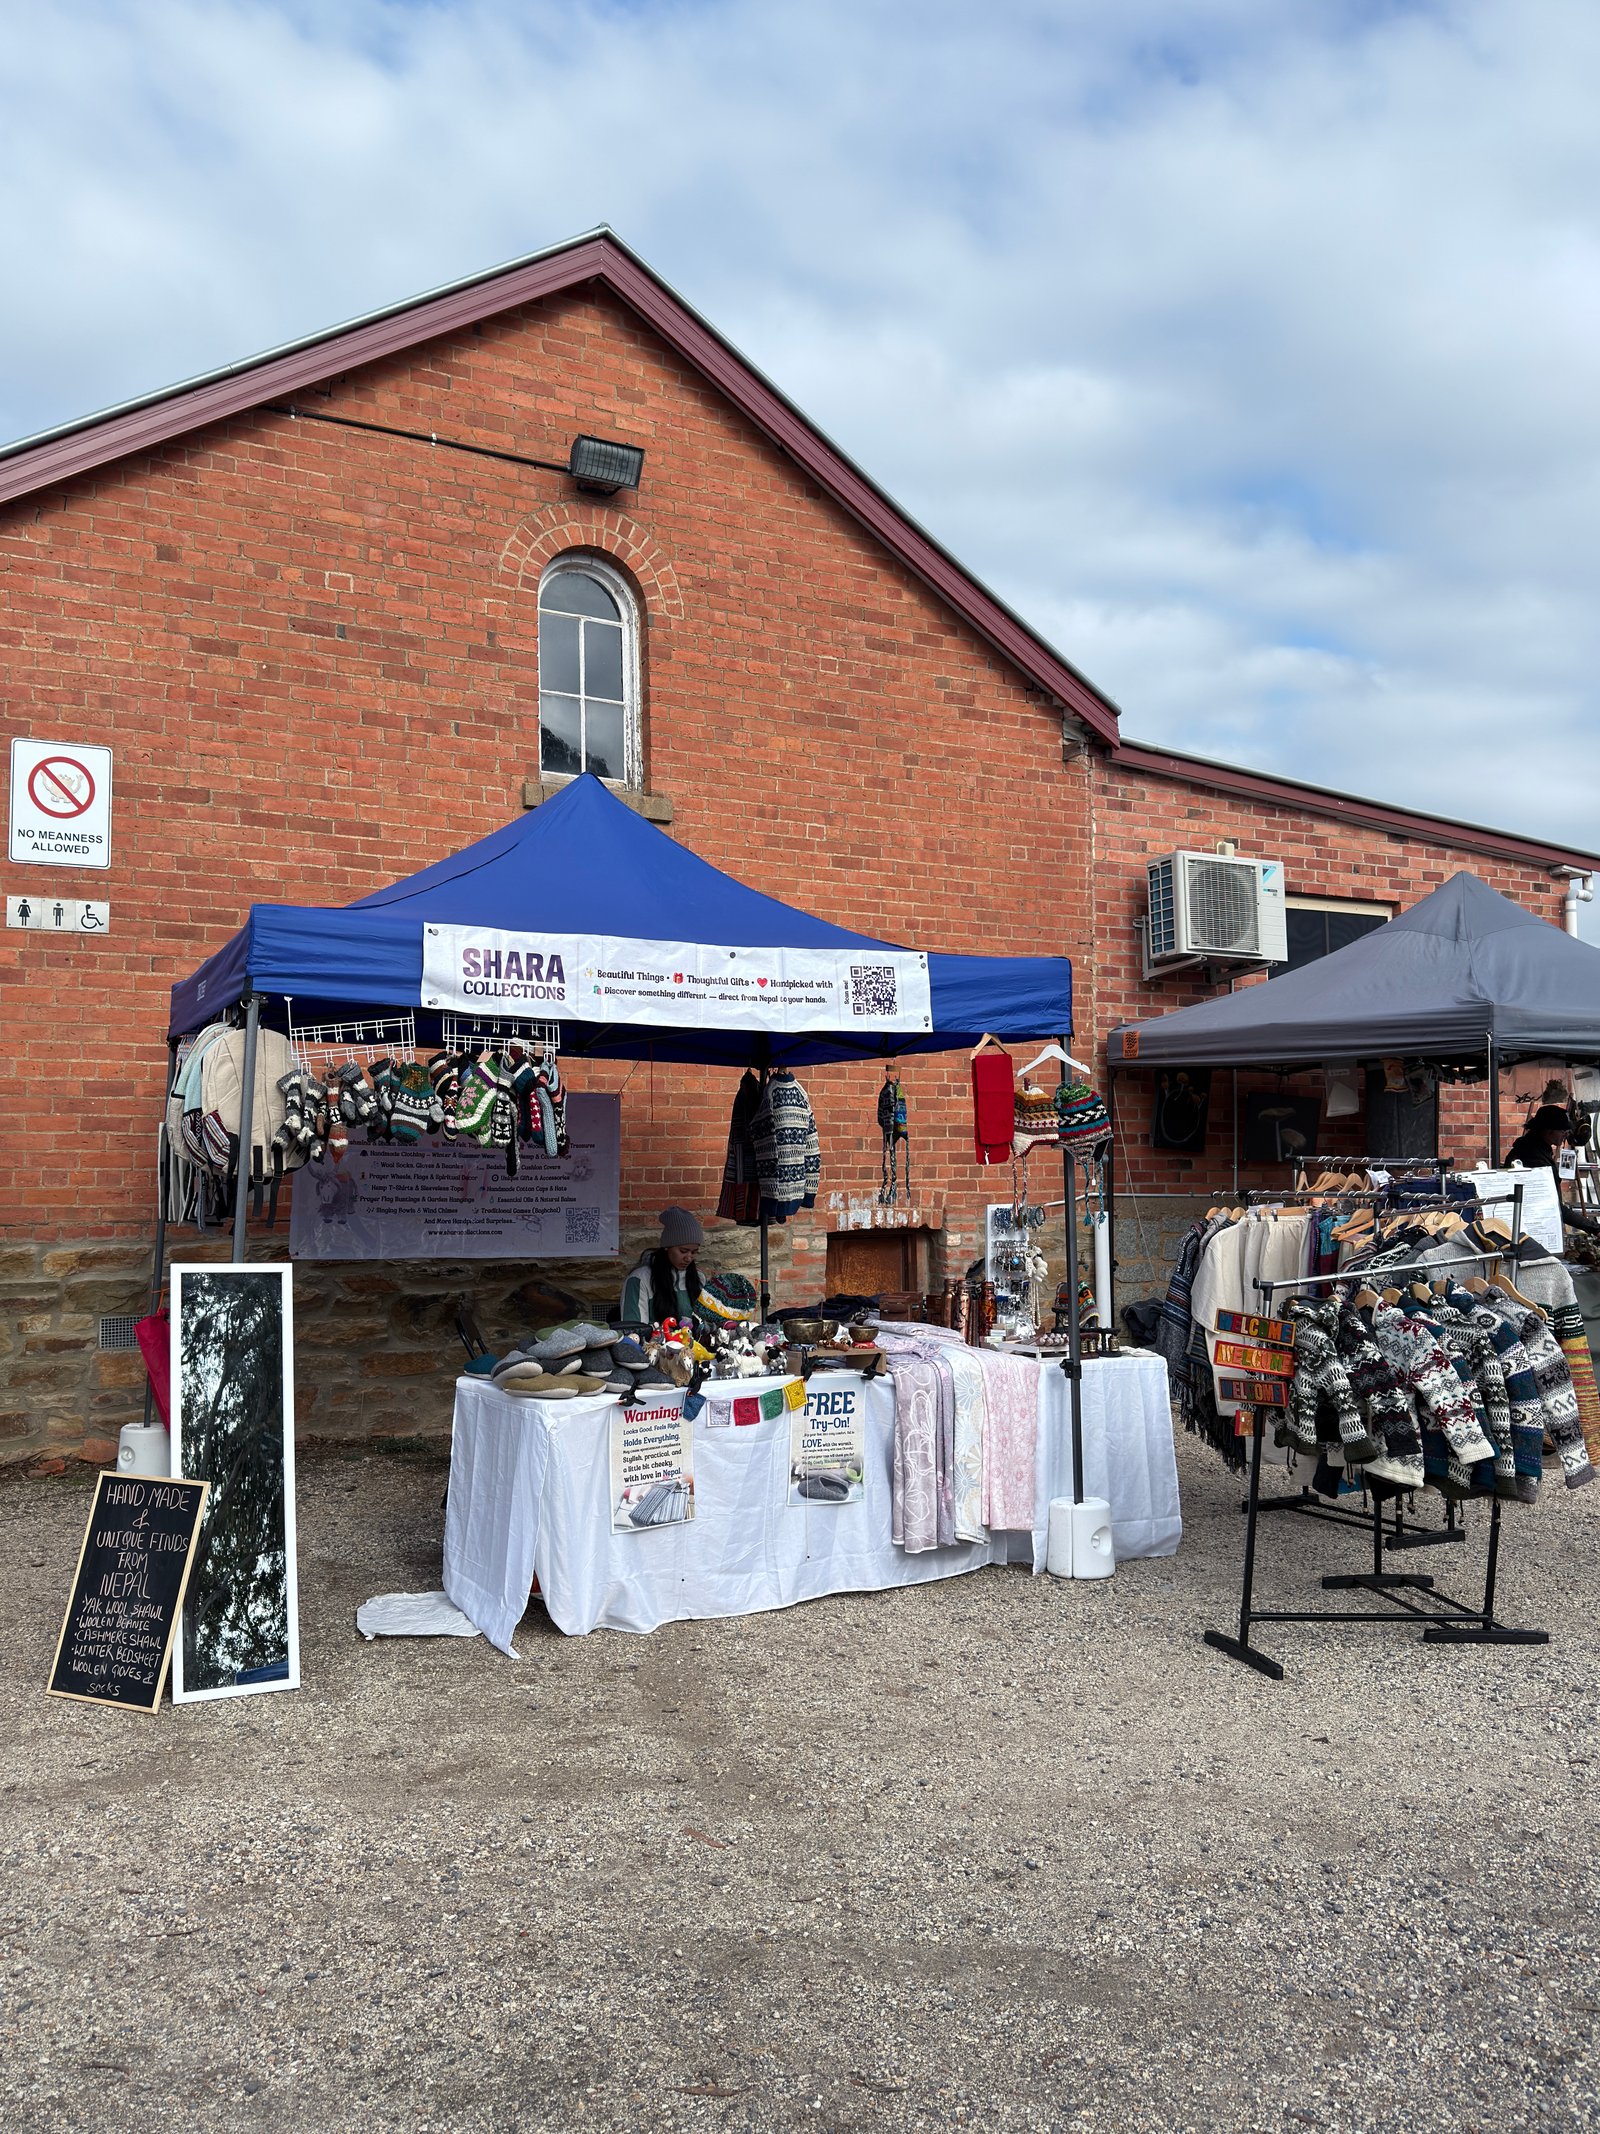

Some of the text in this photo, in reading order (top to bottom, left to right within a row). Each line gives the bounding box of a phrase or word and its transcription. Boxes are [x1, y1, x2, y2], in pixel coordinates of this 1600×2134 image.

[17, 829, 103, 844] NO MEANNESS
[32, 842, 90, 854] ALLOWED
[462, 948, 566, 984] SHARA
[597, 969, 834, 990] Beautiful Things Thoughtful Gifts Handpicked with
[463, 980, 566, 1000] COLLECTIONS
[604, 986, 636, 996] Discover
[638, 988, 676, 1000] something
[677, 990, 707, 1000] different
[759, 995, 778, 1004] Nepal
[1220, 1312, 1292, 1342] WELCOME
[804, 1391, 855, 1416] FREE
[624, 1406, 682, 1424] Warning:
[810, 1417, 850, 1432] Try-On!
[624, 1438, 642, 1447] Holds
[671, 1448, 682, 1456] and
[802, 1438, 822, 1448] LOVE
[624, 1474, 640, 1482] with
[640, 1472, 654, 1480] love
[106, 1484, 191, 1512] HAND MADE
[132, 1508, 150, 1530] &
[96, 1530, 189, 1552] UNIQUE FINDS
[118, 1552, 149, 1574] FROM
[100, 1572, 150, 1599] NEPAL
[106, 1600, 128, 1618] WOOL
[130, 1603, 164, 1621] SHAWL
[116, 1616, 150, 1630] BEANIE
[130, 1634, 162, 1650] SHAWL
[116, 1646, 161, 1668] BEDSHEET
[72, 1659, 108, 1676] WOOLEN
[142, 1672, 154, 1684] &
[86, 1682, 121, 1696] SOCKS
